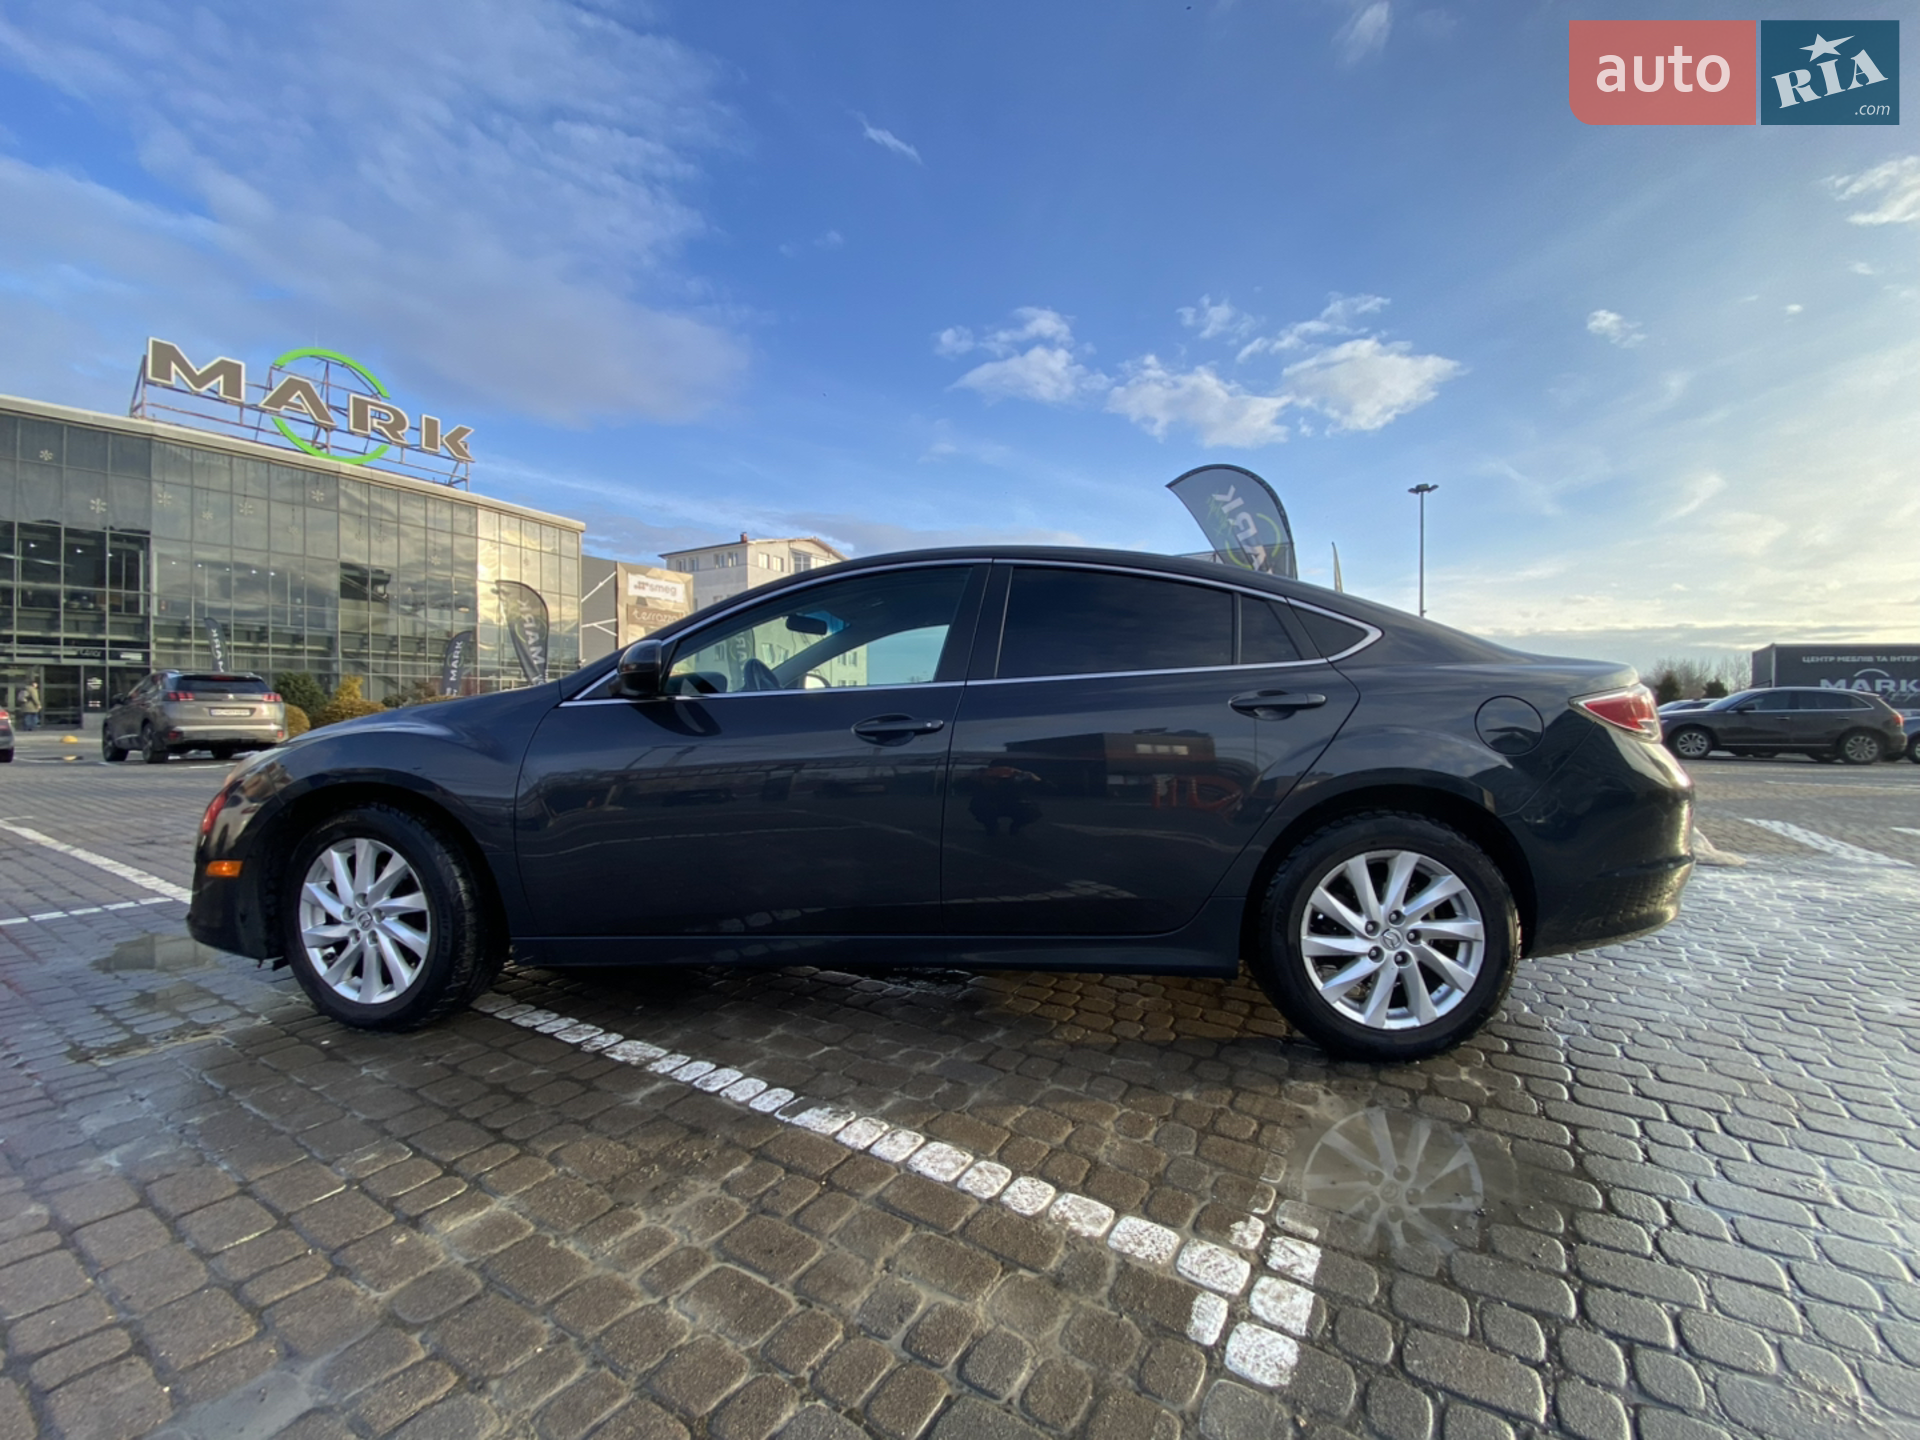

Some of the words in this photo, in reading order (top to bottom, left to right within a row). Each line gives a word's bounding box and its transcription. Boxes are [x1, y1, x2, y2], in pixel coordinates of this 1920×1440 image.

[148, 336, 475, 462] MARK
[649, 583, 678, 597] smeg
[449, 640, 464, 681] MARK
[1802, 655, 1835, 663] ЦЕНТР
[1876, 655, 1888, 663] ТА
[1820, 678, 1920, 692] MARK
